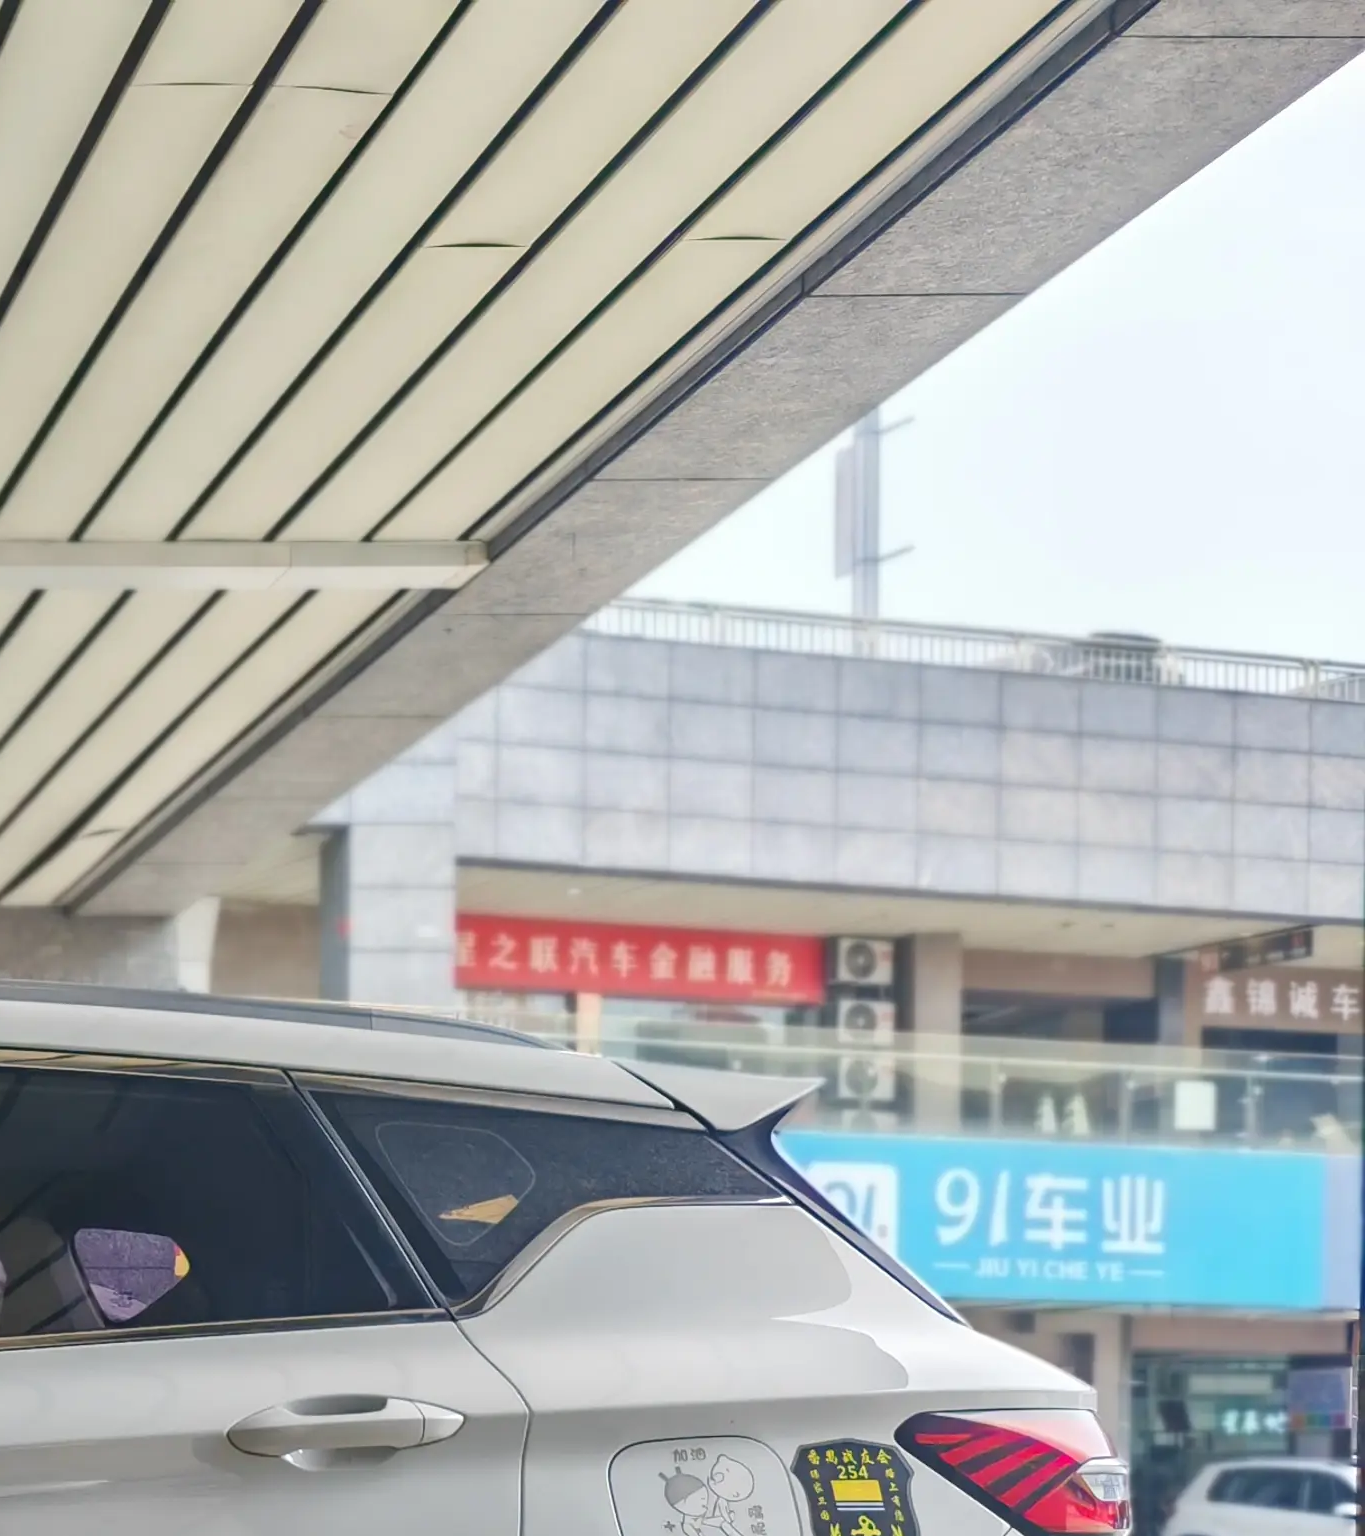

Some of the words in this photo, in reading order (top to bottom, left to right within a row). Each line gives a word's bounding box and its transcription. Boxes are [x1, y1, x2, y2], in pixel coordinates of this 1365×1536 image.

[935, 1167, 1166, 1254] 91车业
[974, 1257, 1010, 1278] JIU
[1016, 1258, 1039, 1278] YI
[1042, 1260, 1089, 1281] CHE
[1095, 1262, 1124, 1282] YE
[672, 1447, 707, 1463] 加油
[836, 1465, 869, 1480] 254
